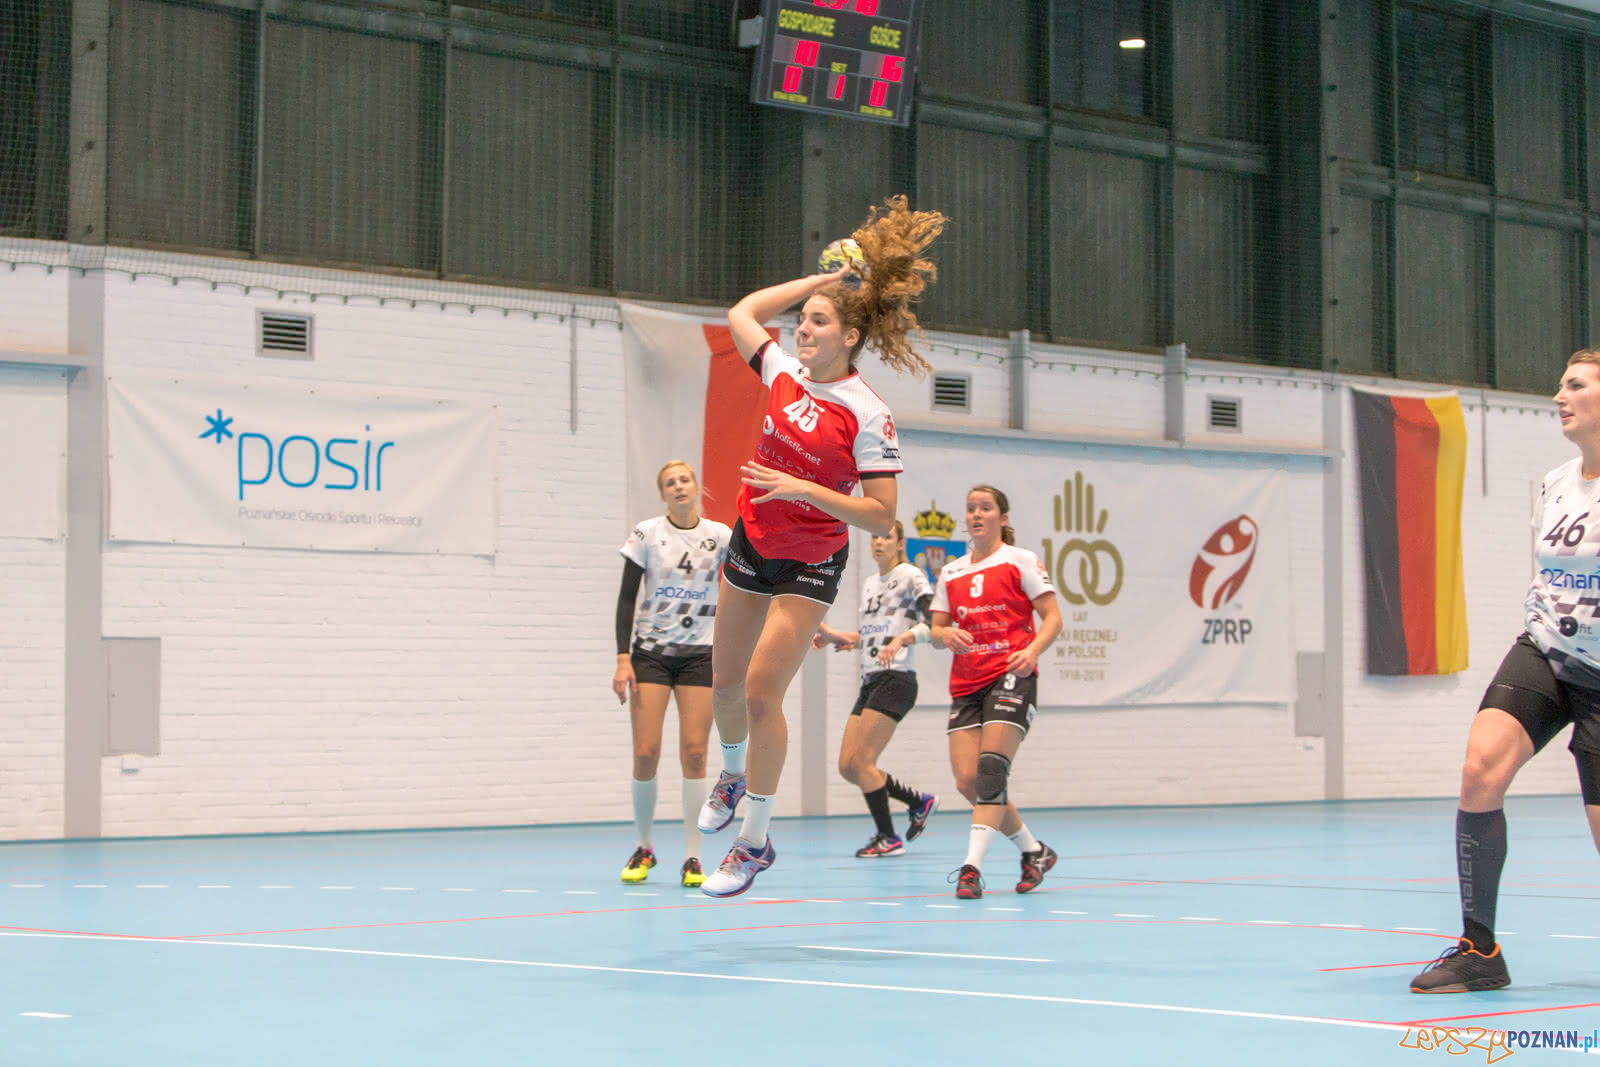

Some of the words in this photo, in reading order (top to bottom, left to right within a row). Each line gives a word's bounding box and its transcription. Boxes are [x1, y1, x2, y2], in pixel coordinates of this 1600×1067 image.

[794, 40, 820, 67] 10
[782, 65, 802, 93] 0
[834, 75, 846, 99] 1
[869, 80, 888, 107] 0
[782, 394, 825, 433] 45
[774, 428, 822, 466] holistic-net
[238, 424, 395, 501] posir
[1542, 511, 1590, 547] 46
[677, 551, 694, 574] 4
[1041, 538, 1125, 606] 100
[796, 575, 825, 586] Kempa
[969, 574, 985, 598] 3
[1200, 618, 1253, 644] ZPRP
[1003, 673, 1017, 690] 3
